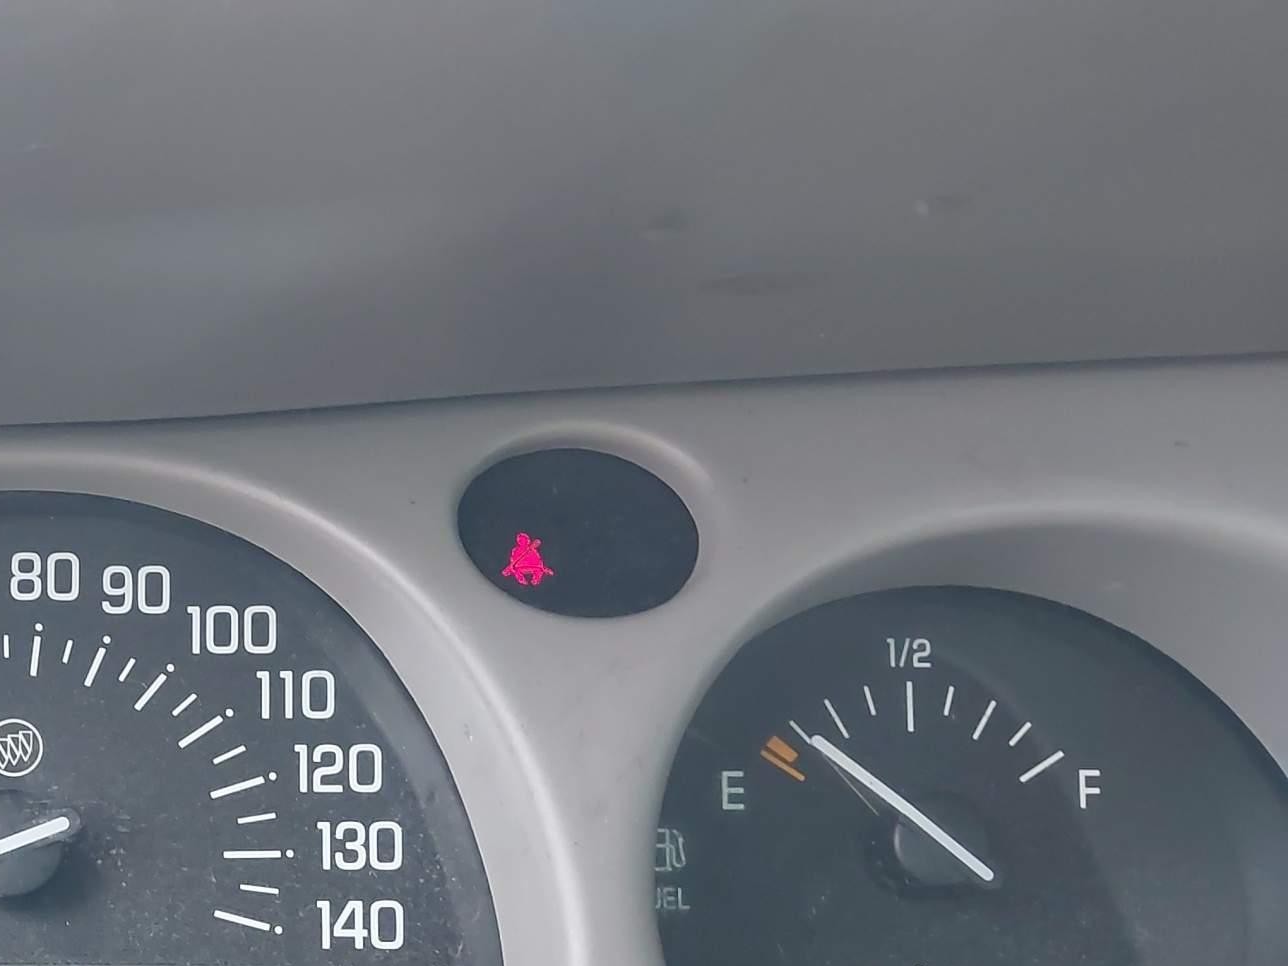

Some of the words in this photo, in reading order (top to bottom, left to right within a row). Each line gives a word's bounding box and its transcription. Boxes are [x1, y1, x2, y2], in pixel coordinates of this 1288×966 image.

[10, 552, 80, 601] 80
[101, 565, 171, 615] 90
[186, 605, 277, 655] 100
[886, 637, 932, 668] 1/2
[256, 670, 335, 720] 110
[294, 743, 383, 793] 120
[721, 770, 745, 810] E
[1078, 769, 1101, 809] F
[316, 820, 403, 871] 130
[316, 899, 405, 950] 140
